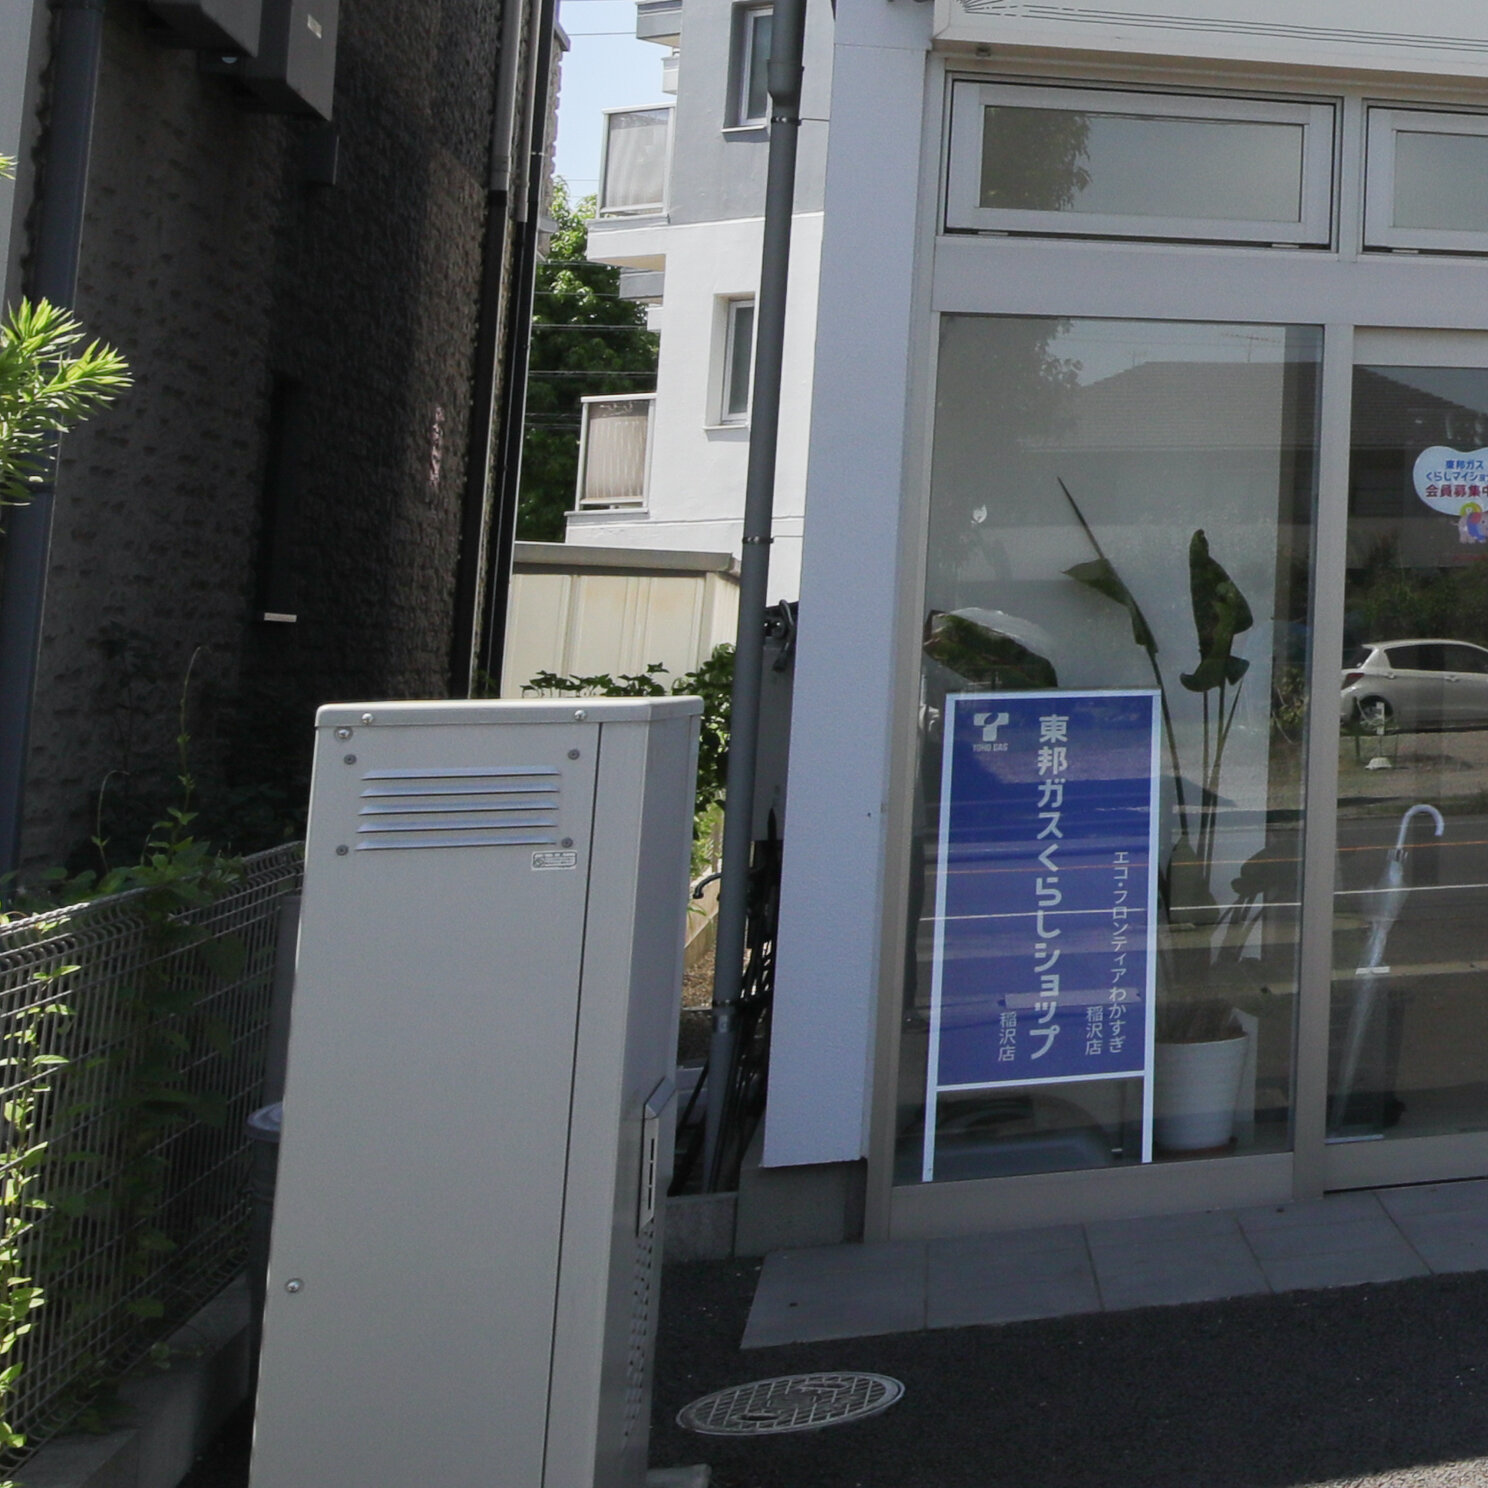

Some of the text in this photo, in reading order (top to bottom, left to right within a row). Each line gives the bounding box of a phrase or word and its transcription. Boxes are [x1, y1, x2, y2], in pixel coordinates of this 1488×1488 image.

[1444, 459, 1485, 470] 東邦ガス
[1030, 714, 1070, 1061] 東邦ガスくらしショップ
[1108, 851, 1130, 1054] エコ・フロンティアわかすぎ
[998, 1011, 1017, 1062] 稲沢店
[1085, 1006, 1104, 1056] 稲沢店
